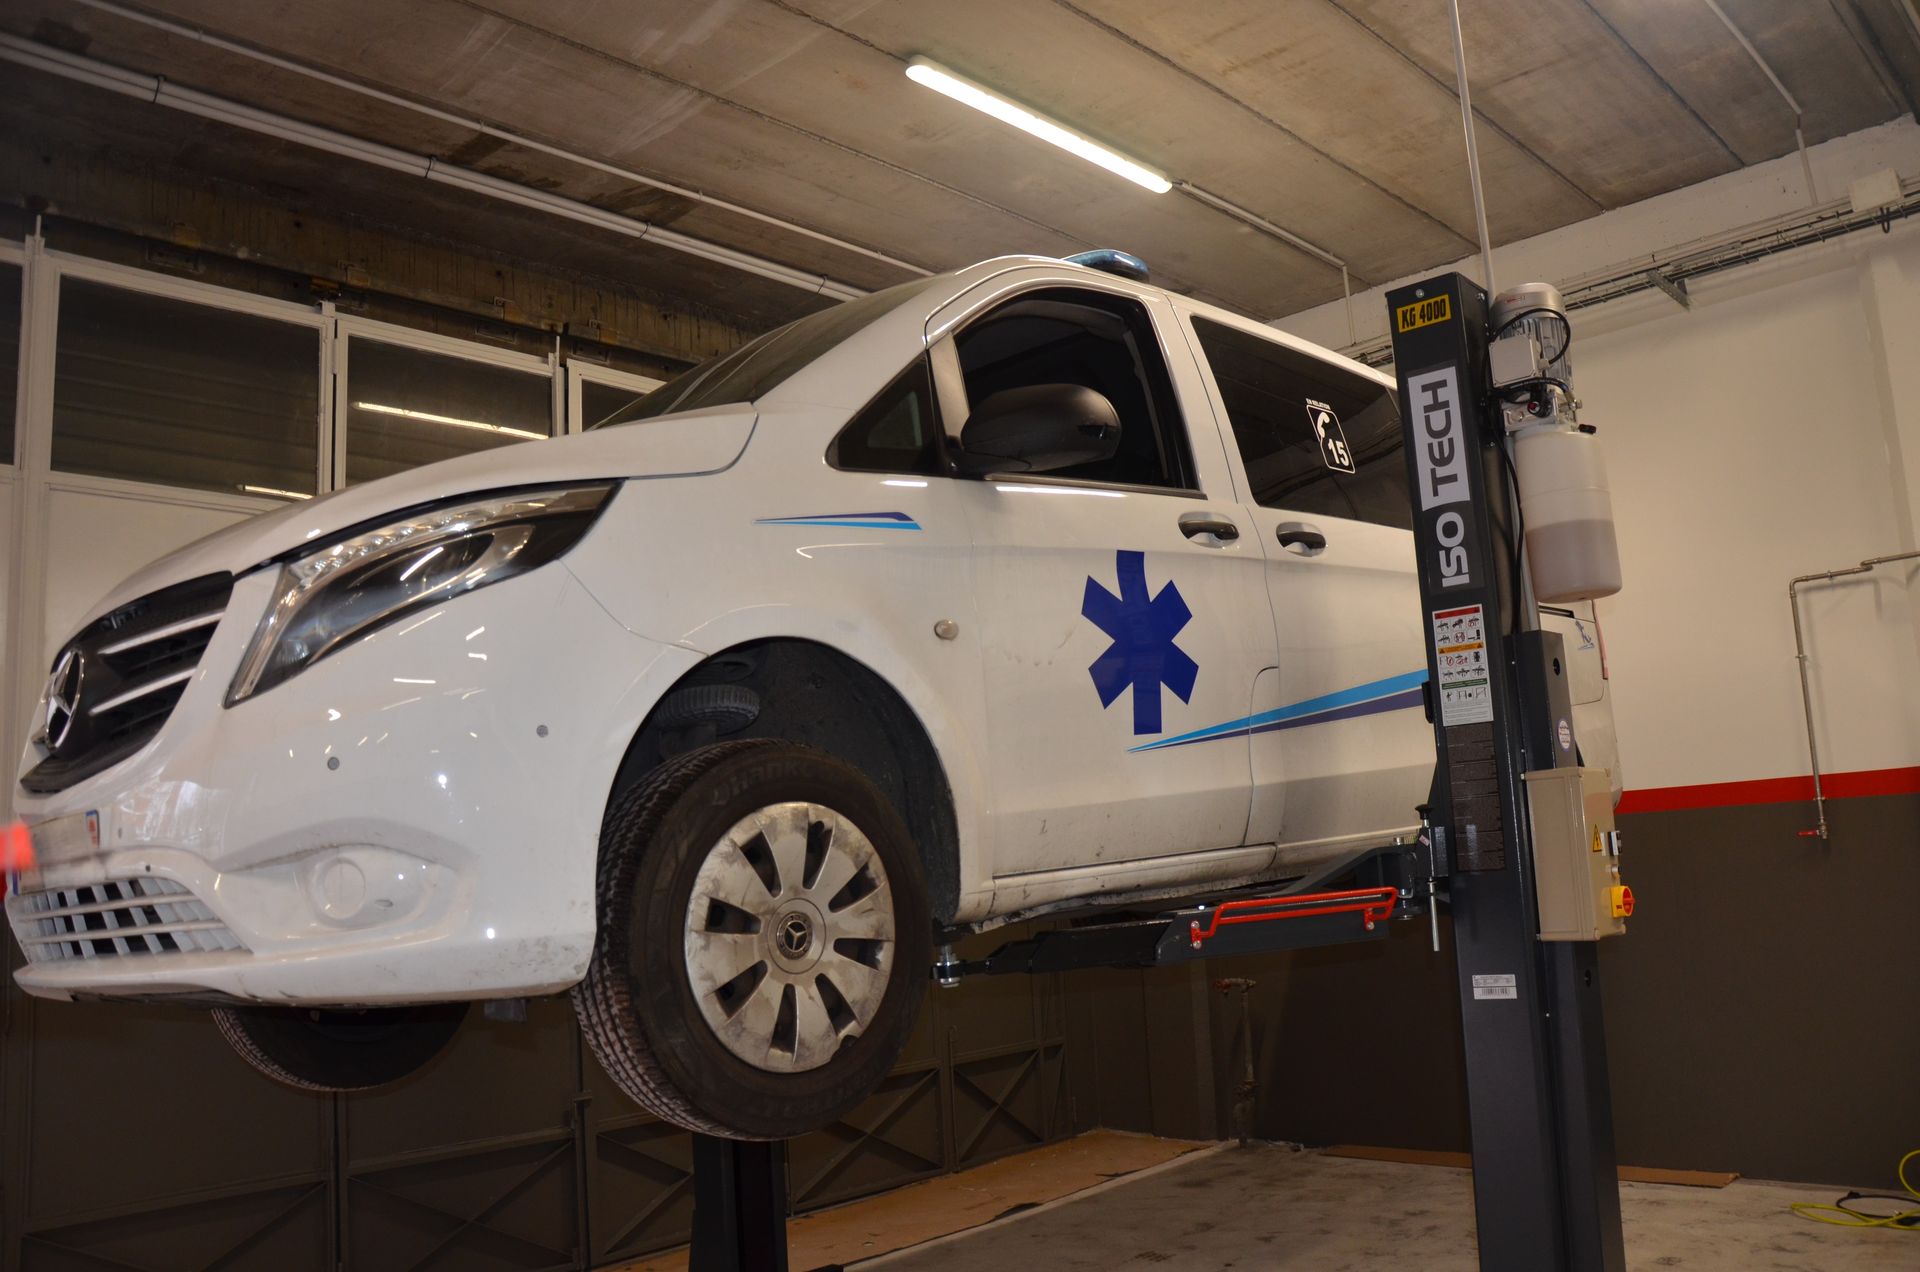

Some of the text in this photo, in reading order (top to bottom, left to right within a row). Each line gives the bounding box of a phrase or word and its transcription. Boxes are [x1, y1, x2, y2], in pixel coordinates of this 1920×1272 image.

[1402, 298, 1446, 329] KG 4000
[1327, 438, 1350, 466] 15
[1421, 379, 1458, 498] TECH
[1436, 512, 1468, 588] ISO
